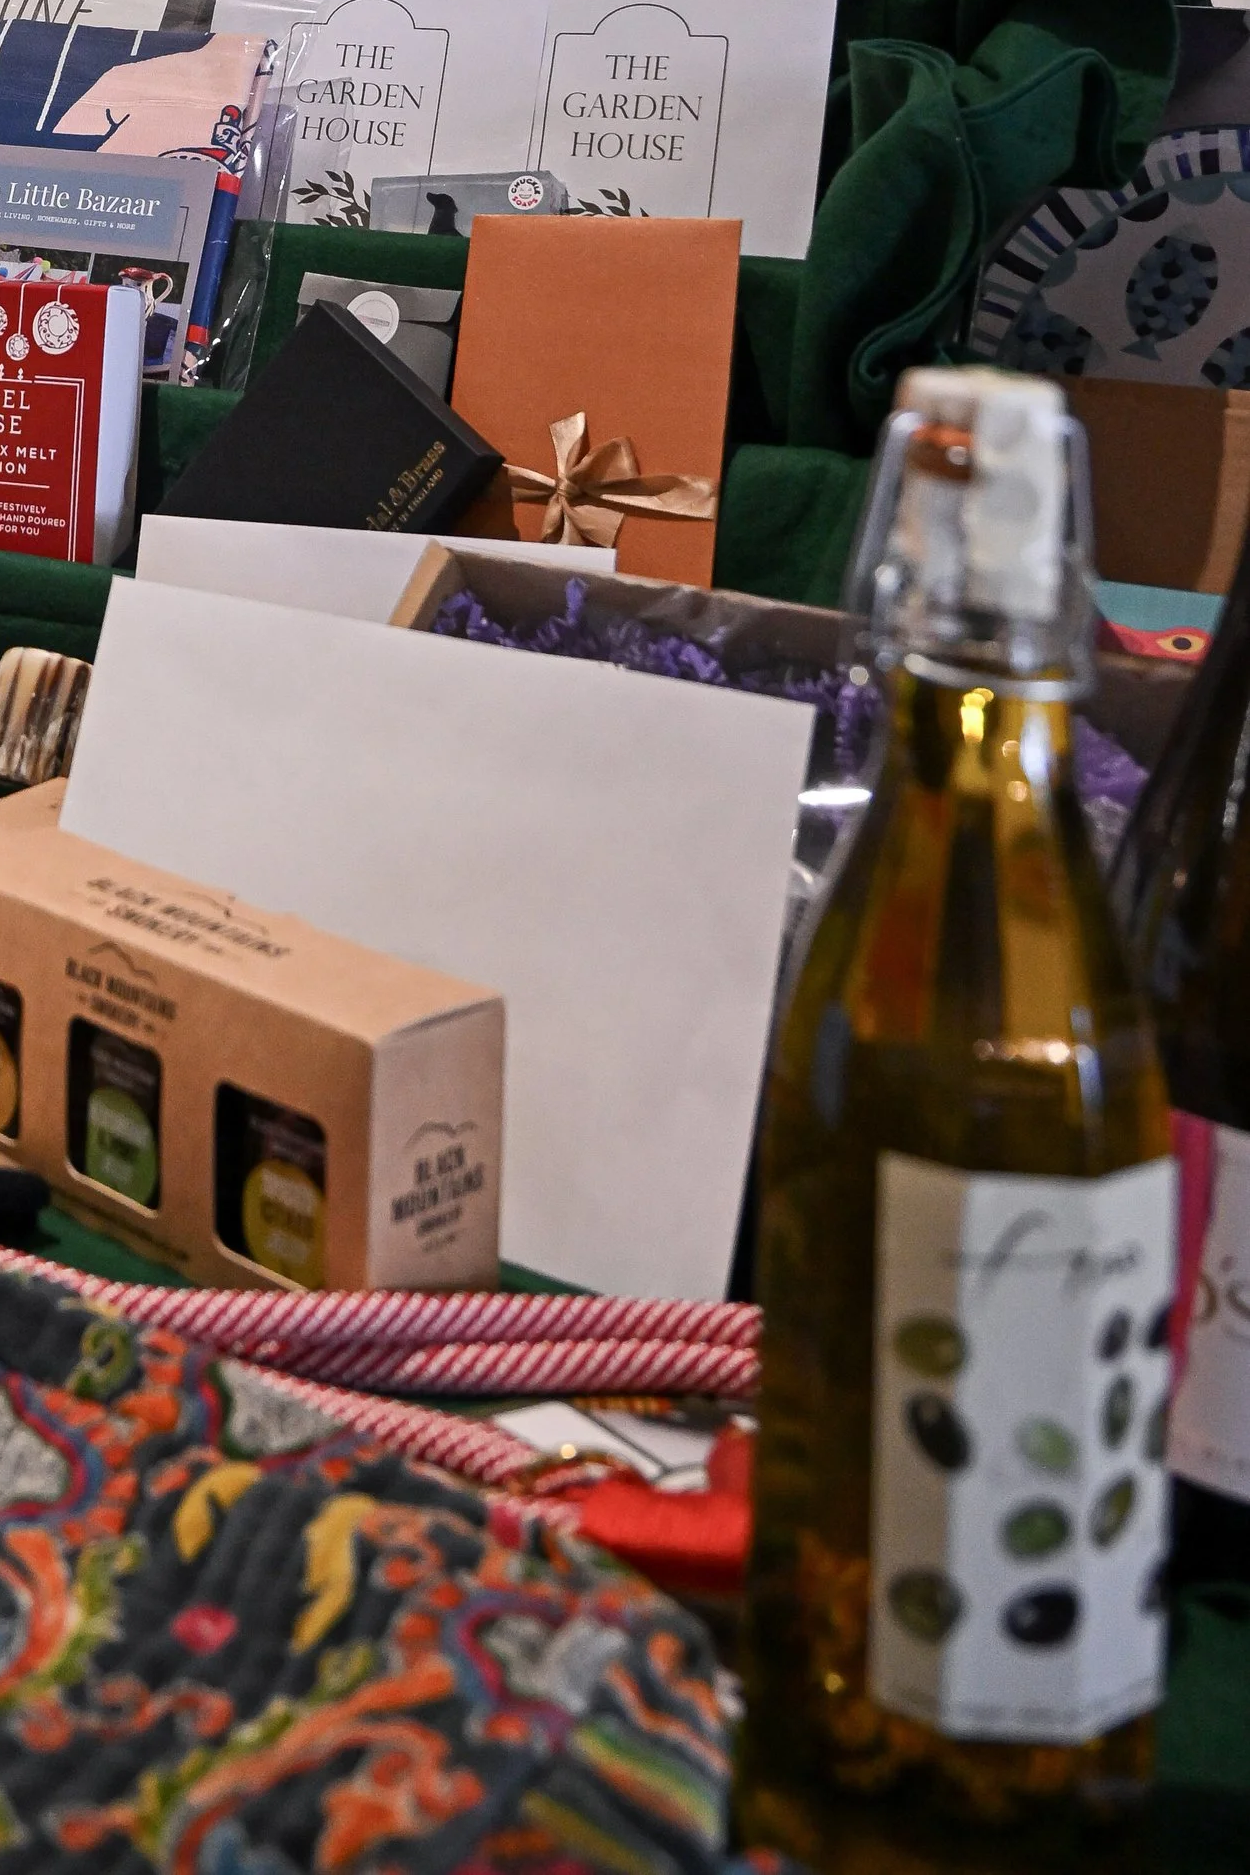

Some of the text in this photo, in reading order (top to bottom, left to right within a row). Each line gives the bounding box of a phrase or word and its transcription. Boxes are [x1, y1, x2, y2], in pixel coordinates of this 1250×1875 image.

[336, 43, 394, 71] THE
[605, 55, 670, 81] THE
[296, 79, 424, 109] GARDEN
[563, 92, 702, 121] GARDEN
[302, 117, 407, 147] HOUSE
[571, 132, 684, 161] HOUSE
[7, 182, 70, 209] Little
[77, 189, 160, 217] Bazaar
[511, 179, 540, 194] CHUCKLE
[512, 197, 538, 206] SOAPS
[4, 213, 33, 221] LIVING,
[37, 215, 80, 225] HOMEWARES,
[16, 446, 57, 460] MELT
[397, 441, 446, 492] Brass
[389, 487, 407, 505] &
[408, 469, 443, 511] ENGLAND
[0, 513, 25, 523] HAND
[28, 515, 66, 527] POURED
[0, 523, 18, 533] FOR
[20, 525, 40, 535] YOU
